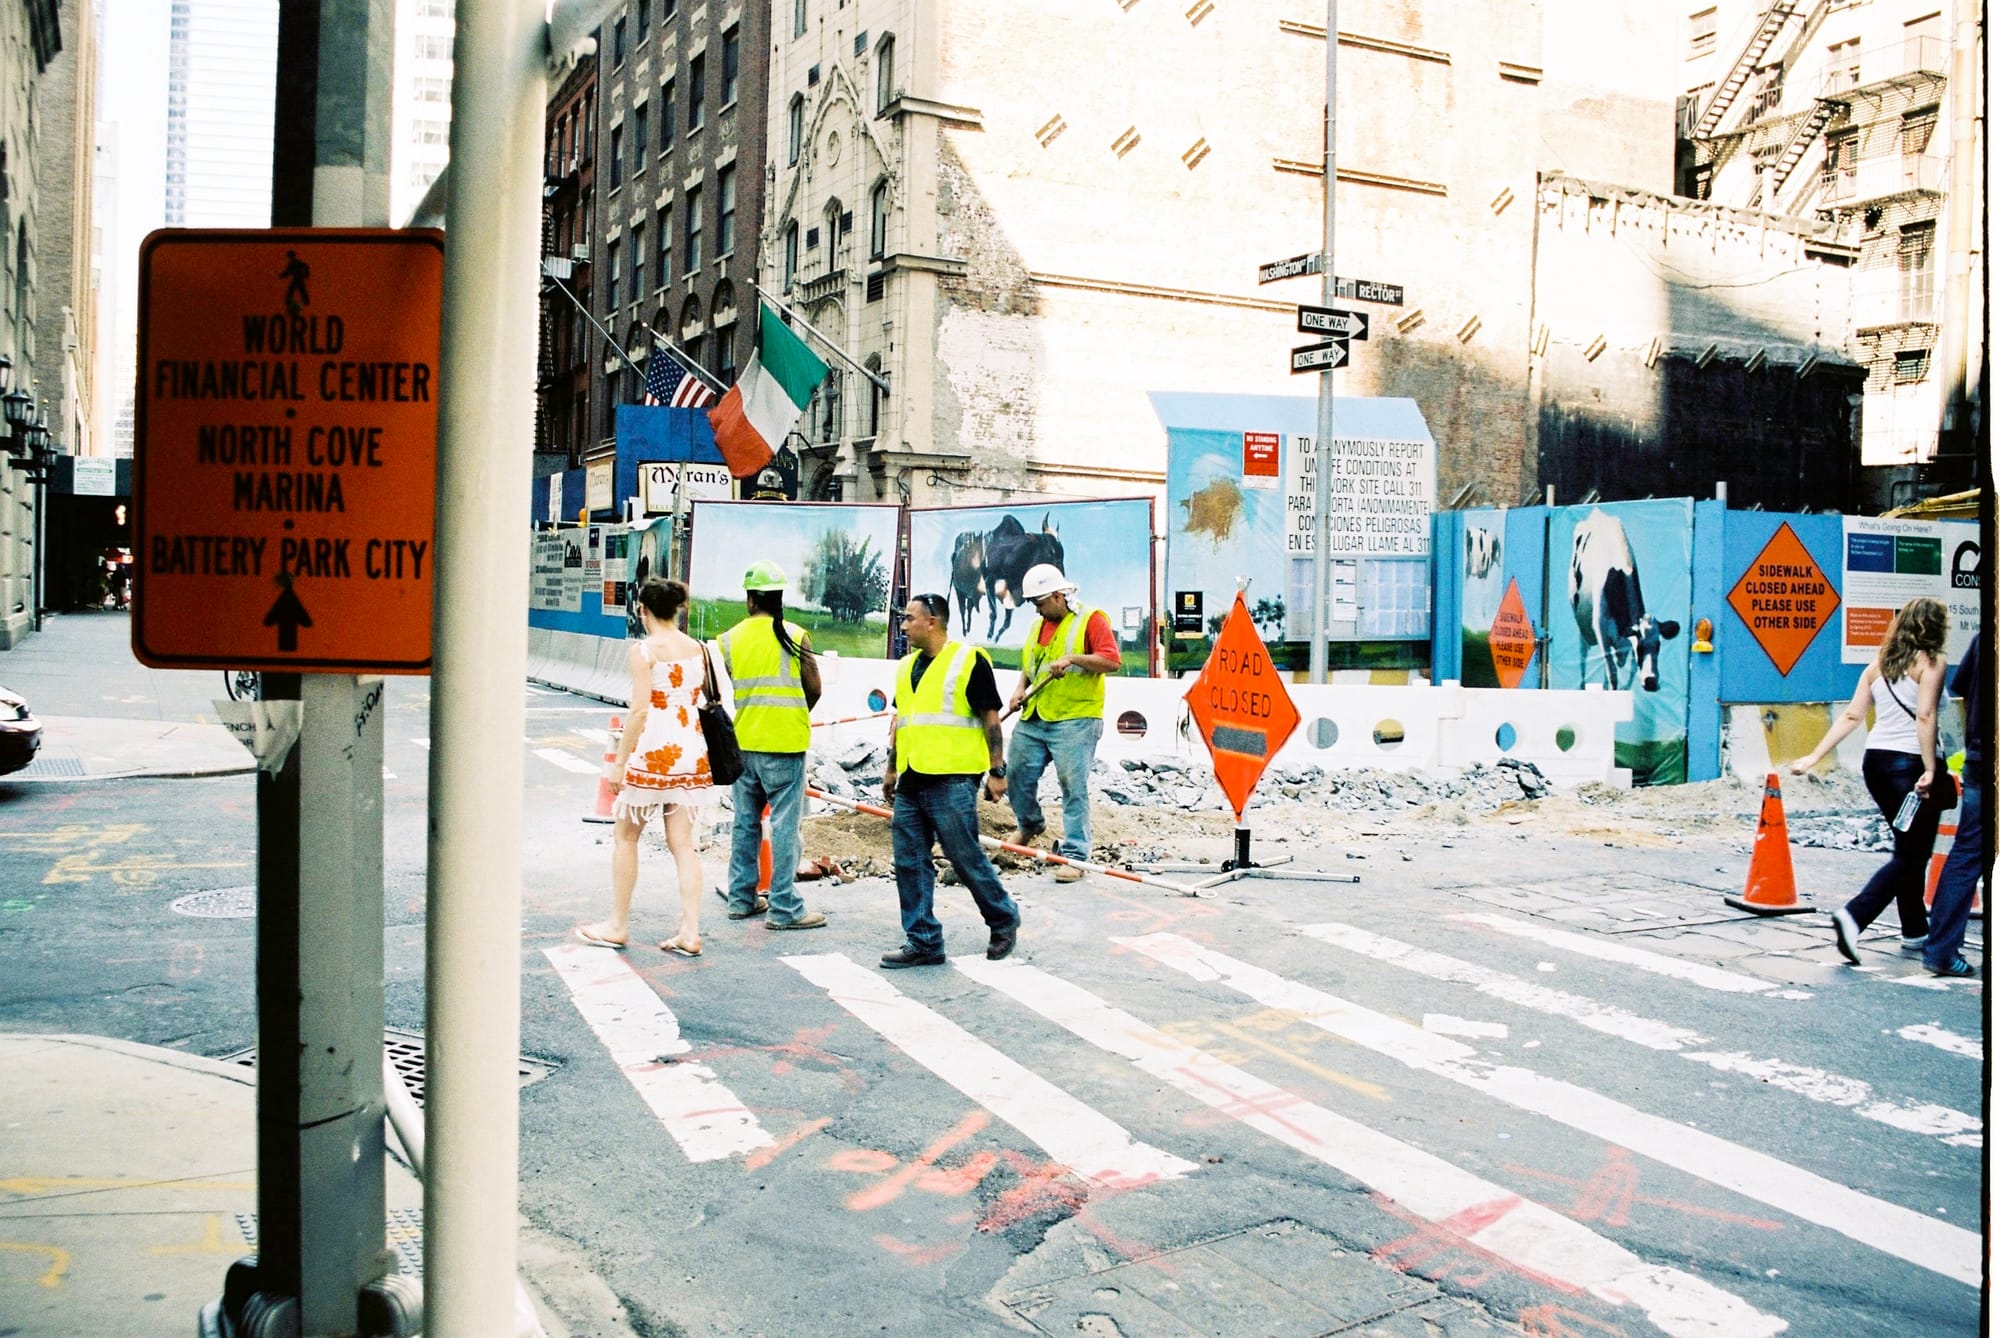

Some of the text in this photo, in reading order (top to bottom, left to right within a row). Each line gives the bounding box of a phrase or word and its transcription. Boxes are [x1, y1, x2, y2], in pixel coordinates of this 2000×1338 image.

[1260, 260, 1302, 282] WASHINGTON
[1359, 284, 1395, 303] RECTOR
[1306, 314, 1348, 330] ONE WAY
[242, 314, 344, 355] WORLD
[1298, 348, 1340, 366] ONE WAY
[155, 359, 430, 403] FINANCIAL CENTER
[197, 424, 384, 468] NORTH COVE
[1250, 444, 1274, 452] ANYTIME
[1254, 435, 1278, 444] STANDING
[1298, 437, 1424, 459] TO NYMOUSLY REPORT
[652, 466, 730, 486] Moran's
[1304, 457, 1416, 478] UNFE CONDITIONS AT
[232, 472, 346, 512] MARINA
[1300, 476, 1316, 492] THI
[1360, 479, 1380, 495] SITE
[1384, 480, 1405, 496] CALL
[1408, 481, 1422, 496] 311
[1288, 496, 1312, 512] PARA
[1331, 497, 1354, 513] ORTA
[1298, 515, 1422, 534] CONCIONES PELIGROSAS
[1858, 521, 1932, 534] What's Going On Here?
[1288, 534, 1302, 550] EN
[1333, 536, 1364, 552] LUGAR
[1368, 536, 1399, 552] LLAME
[1403, 538, 1414, 552] AL
[1418, 538, 1430, 553] 311
[151, 535, 428, 580] BATTERY PARK CITY
[1758, 564, 1814, 580] SIDEWALK
[1956, 574, 1980, 587] CON
[1746, 581, 1825, 596] CLOSED AHEAD
[1752, 599, 1816, 612] PLEASE USE
[1959, 604, 1980, 616] South
[1754, 616, 1817, 630] OTHER SIDE
[1512, 628, 1528, 640] AHEAD
[1496, 640, 1524, 654] PLEASE USE
[1220, 648, 1263, 676] ROAD
[1513, 657, 1524, 669] SIDE
[1210, 686, 1272, 718] CLOSED
